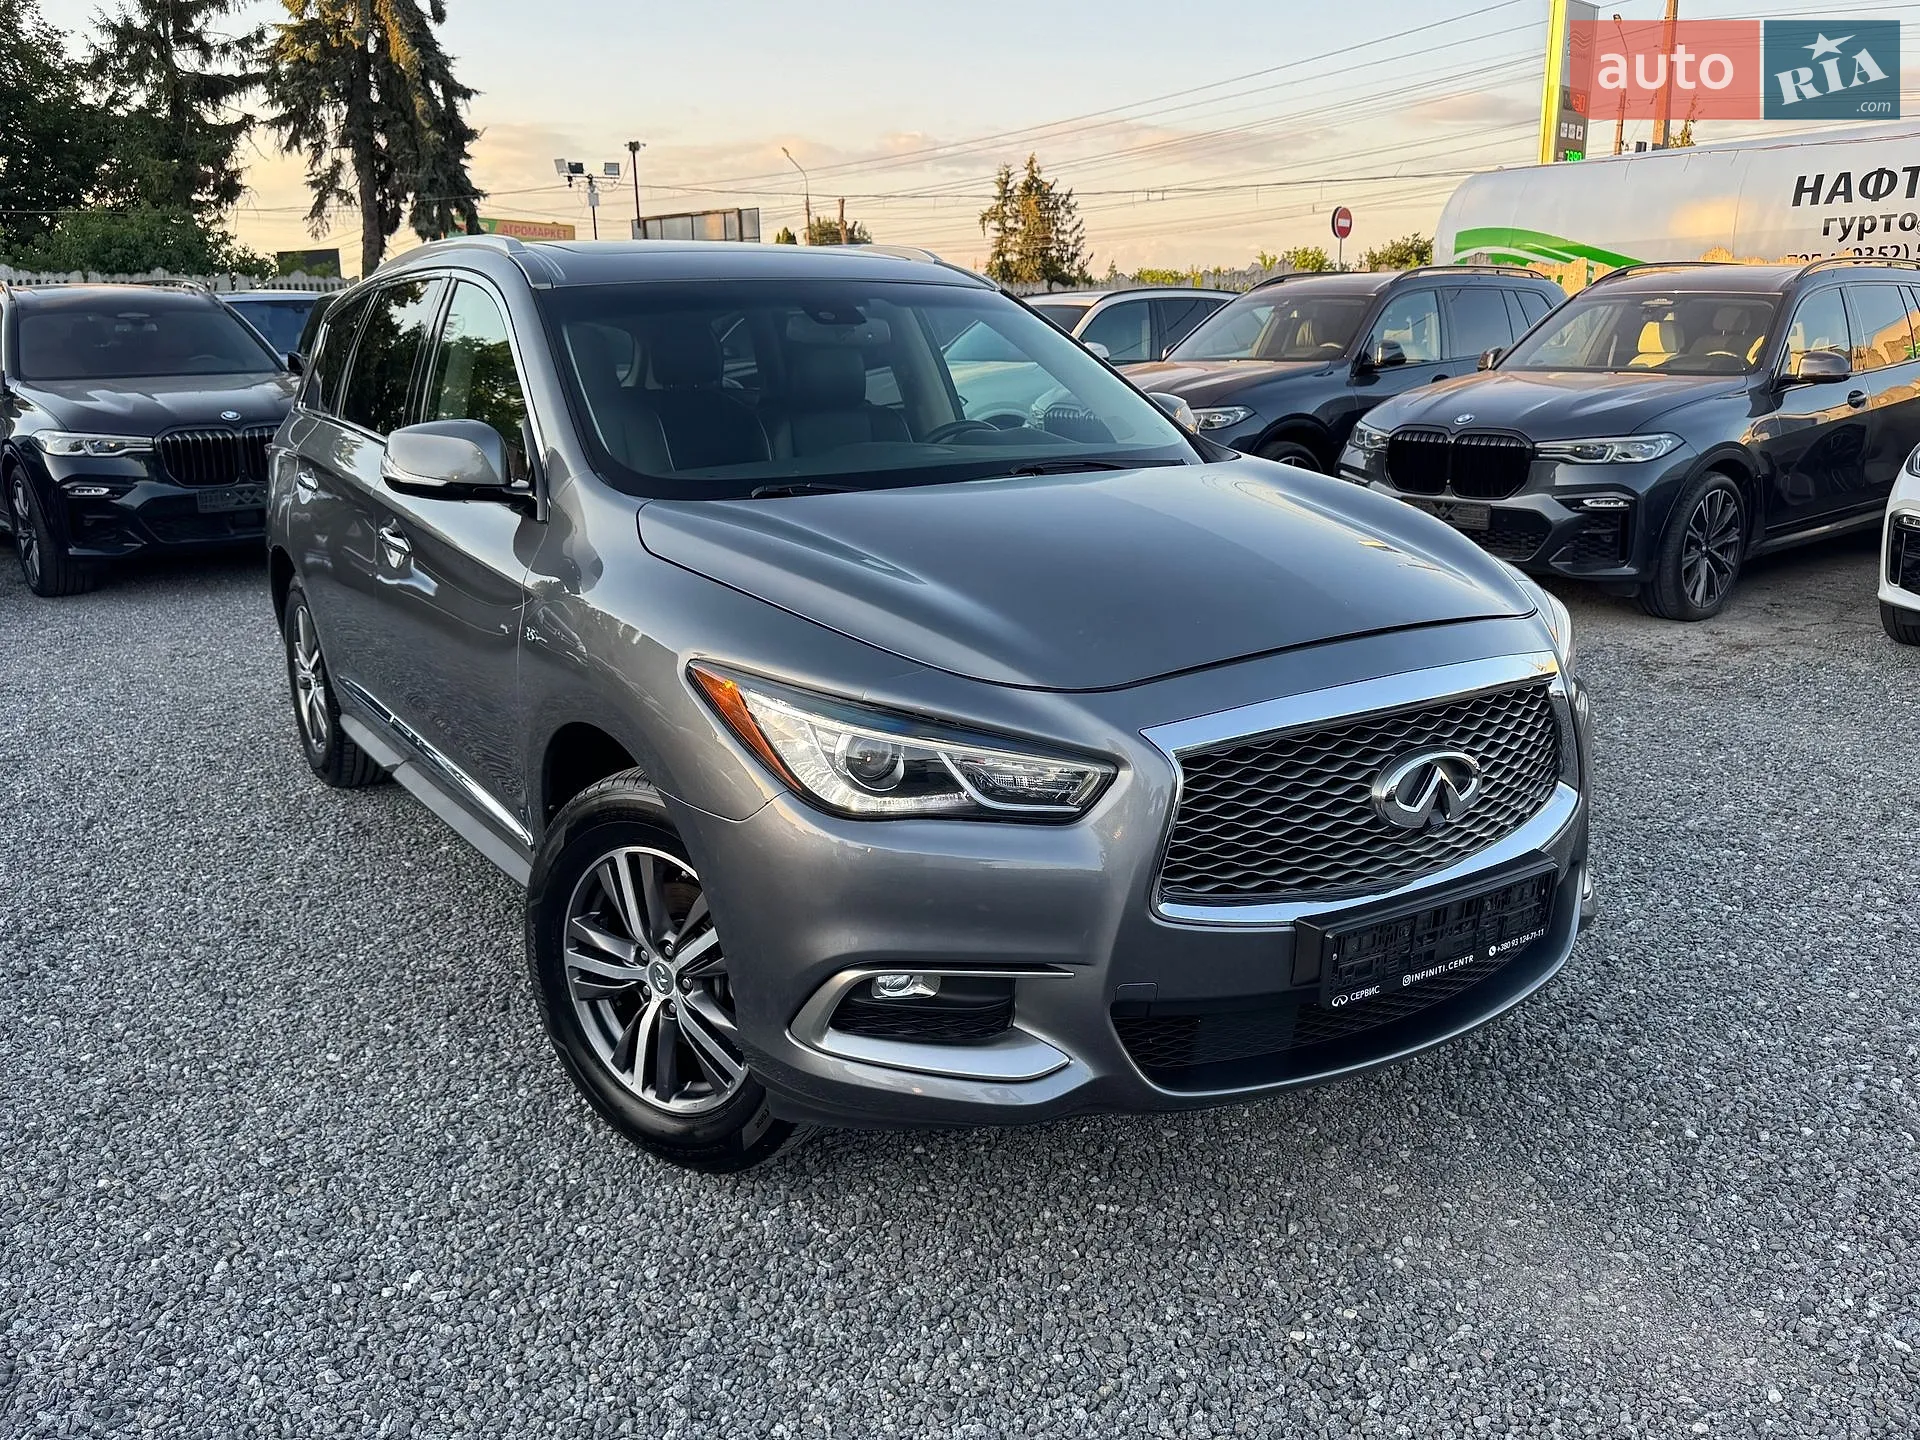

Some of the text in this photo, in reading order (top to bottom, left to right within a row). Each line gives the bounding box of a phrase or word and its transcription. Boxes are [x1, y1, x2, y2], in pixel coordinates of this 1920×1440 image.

[1792, 166, 1920, 207] НАФТ
[502, 224, 568, 239] АГРОМАРКЕТ
[1497, 941, 1511, 952] +380
[1511, 938, 1519, 947] 93
[1350, 986, 1380, 1001] СЕРВИС
